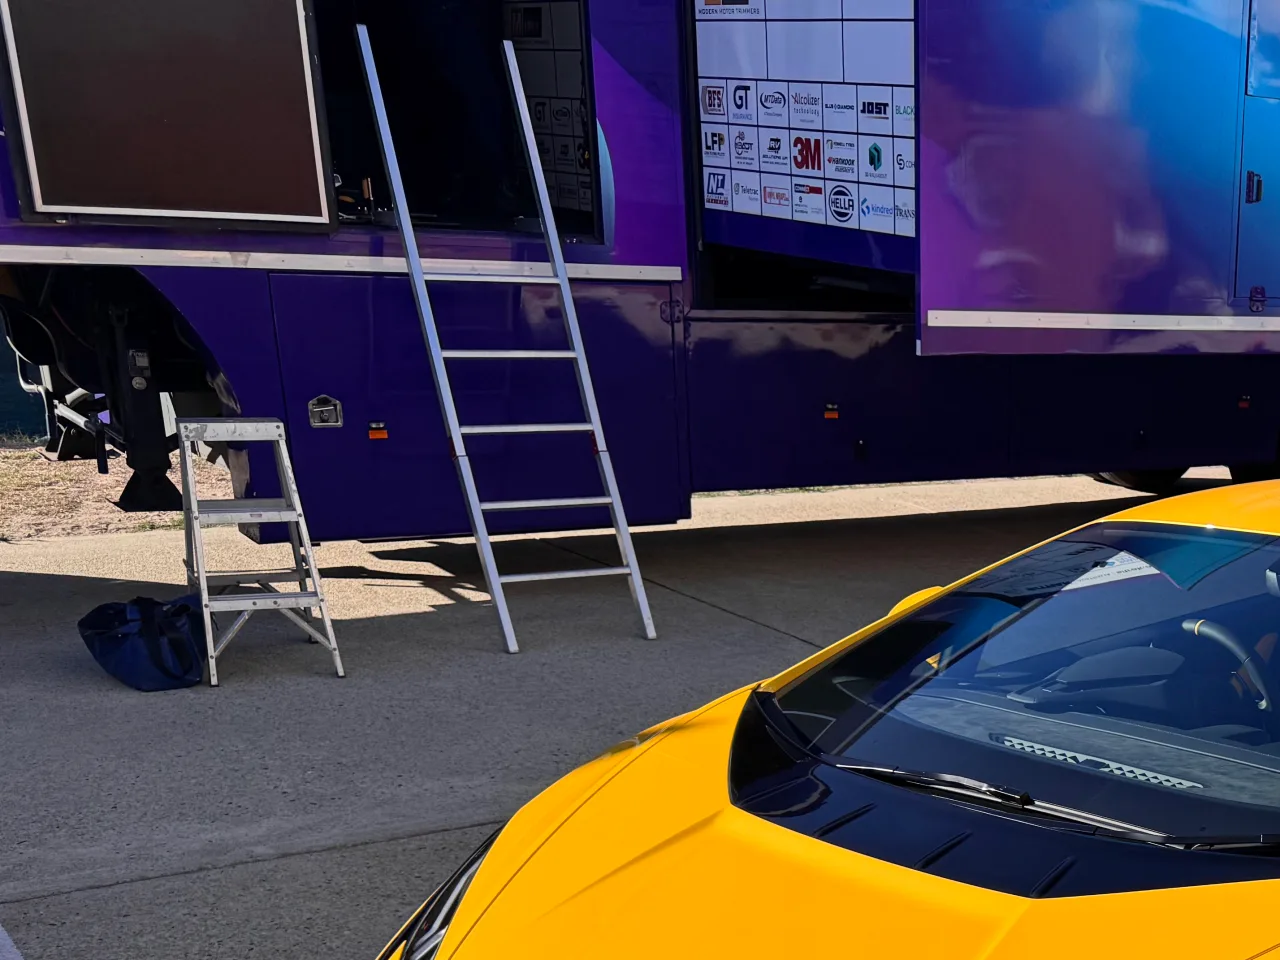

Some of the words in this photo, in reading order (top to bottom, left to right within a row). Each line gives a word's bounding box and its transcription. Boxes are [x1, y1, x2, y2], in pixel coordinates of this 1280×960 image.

[707, 89, 722, 108] BFS
[733, 85, 751, 110] GT
[791, 92, 820, 106] Alcolizer
[793, 107, 820, 117] technology
[860, 101, 889, 115] JOST
[704, 131, 725, 151] LFP
[792, 136, 821, 171] 3M
[741, 185, 759, 195] Teletrac
[831, 197, 854, 211] HELLA
[871, 203, 893, 215] kindred
